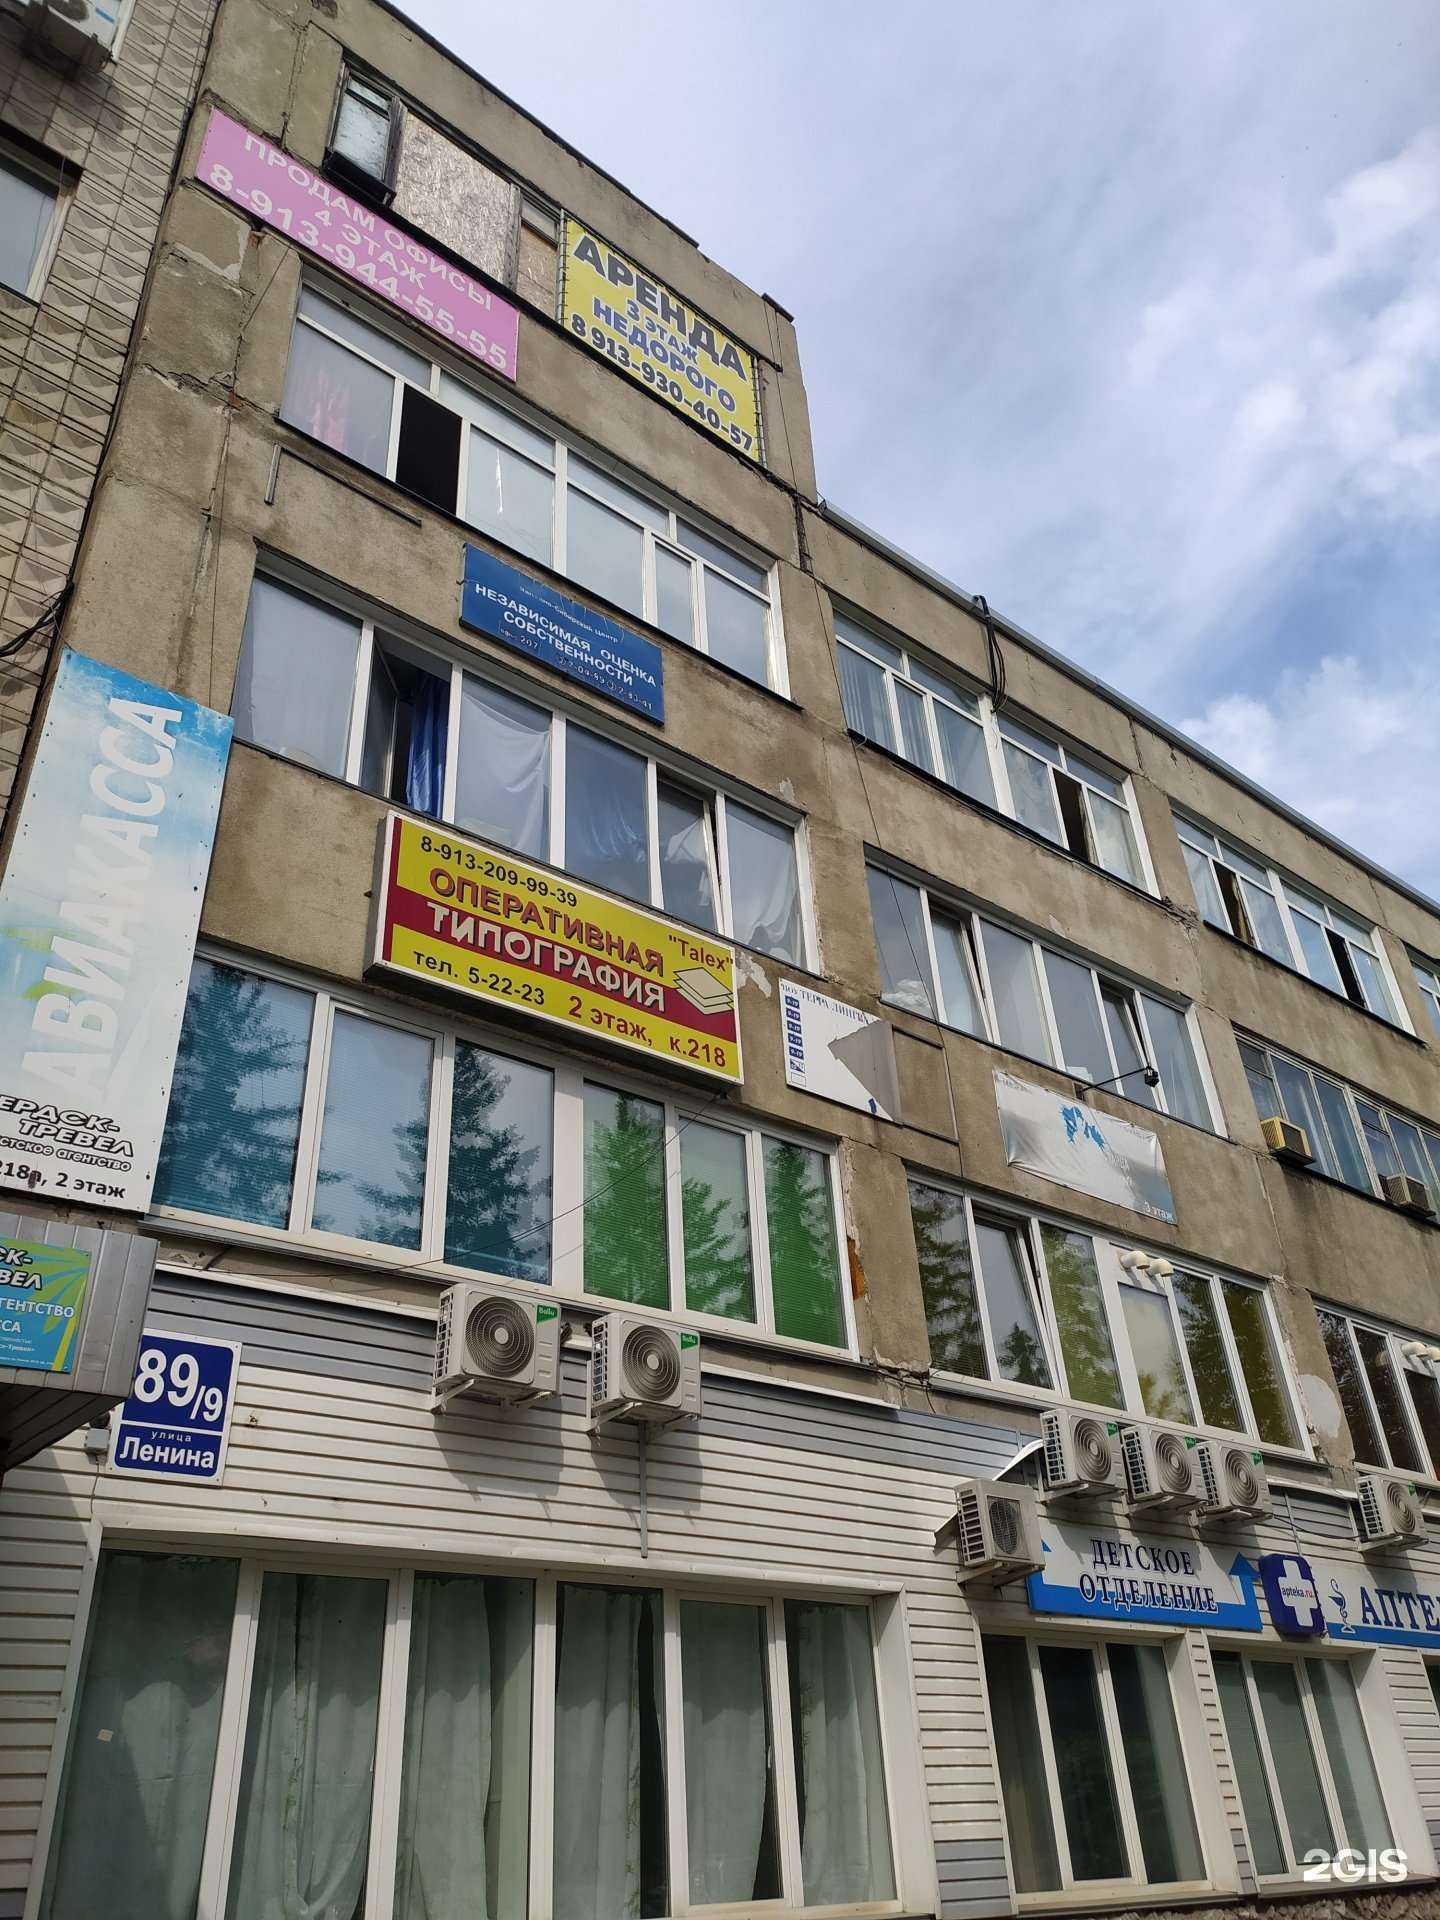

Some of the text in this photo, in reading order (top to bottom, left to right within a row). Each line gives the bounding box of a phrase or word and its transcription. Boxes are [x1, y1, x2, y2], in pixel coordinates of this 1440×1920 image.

[245, 135, 493, 311] ПРОДАМ ОФИСЫ
[315, 209, 427, 290] 4 ЭТАЖ
[209, 163, 507, 370] 8-913-944-55-55
[573, 234, 748, 382] АРЕНДА
[626, 299, 698, 364] 3 ЭТАЖ
[571, 313, 753, 452] 8 913-930-40-57
[593, 296, 736, 413] НЕДОРОГО
[475, 583, 591, 652] НЕЗАВИСИМАЯ
[600, 649, 657, 688] ОЦЕНКА
[503, 610, 634, 687] СОБСТВЕННОСТИ
[22, 696, 183, 1098] АВИАКАССА
[420, 835, 579, 908] 8-913-209-99-39
[426, 901, 666, 1013] ТИПОГРАФИЯ
[429, 867, 665, 978] ОПЕРАТИВНАЯ
[668, 934, 735, 973] "Talex"
[413, 950, 728, 1068] тел. 5-22-23 2 этаж, к.218
[19, 1118, 134, 1158] ТРЕВЕЛ
[56, 1148, 132, 1173] агентство
[55, 1172, 69, 1188] 2
[73, 1178, 126, 1199] этаж
[134, 1348, 224, 1423] 89/9
[119, 1436, 216, 1469] Ленина
[151, 1429, 193, 1443] улица
[1079, 1573, 1220, 1615] ОТДЕЛЕНИЕ
[1091, 1538, 1196, 1577] ДЕТСКОЕ
[1281, 1586, 1313, 1599] apteka.ru
[1360, 1586, 1440, 1632] АПТЕ
